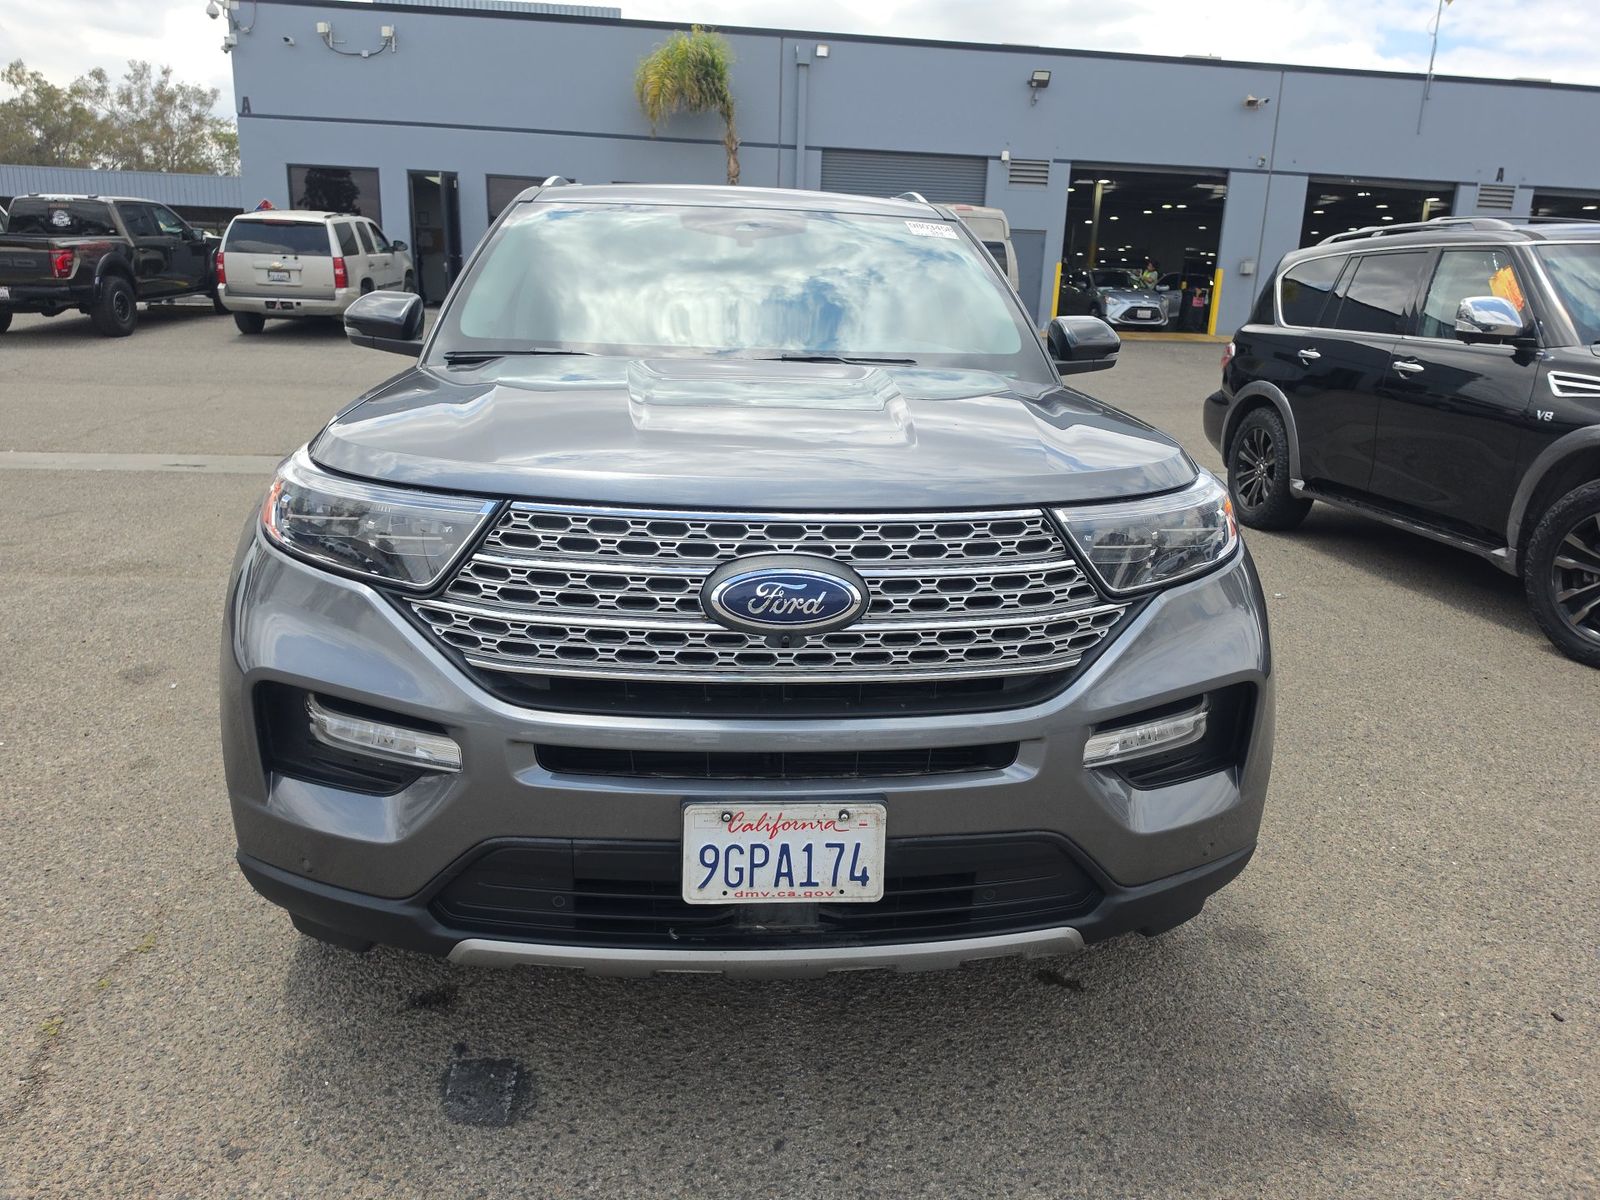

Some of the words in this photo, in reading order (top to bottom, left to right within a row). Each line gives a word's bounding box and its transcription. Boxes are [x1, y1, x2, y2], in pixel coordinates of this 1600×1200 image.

[241, 96, 252, 113] A
[1495, 167, 1505, 182] A
[1536, 409, 1554, 422] V8
[747, 581, 827, 615] Ford
[727, 811, 850, 839] California
[697, 842, 870, 889] 9GPA174
[734, 889, 836, 899] dmv.ca.gov
